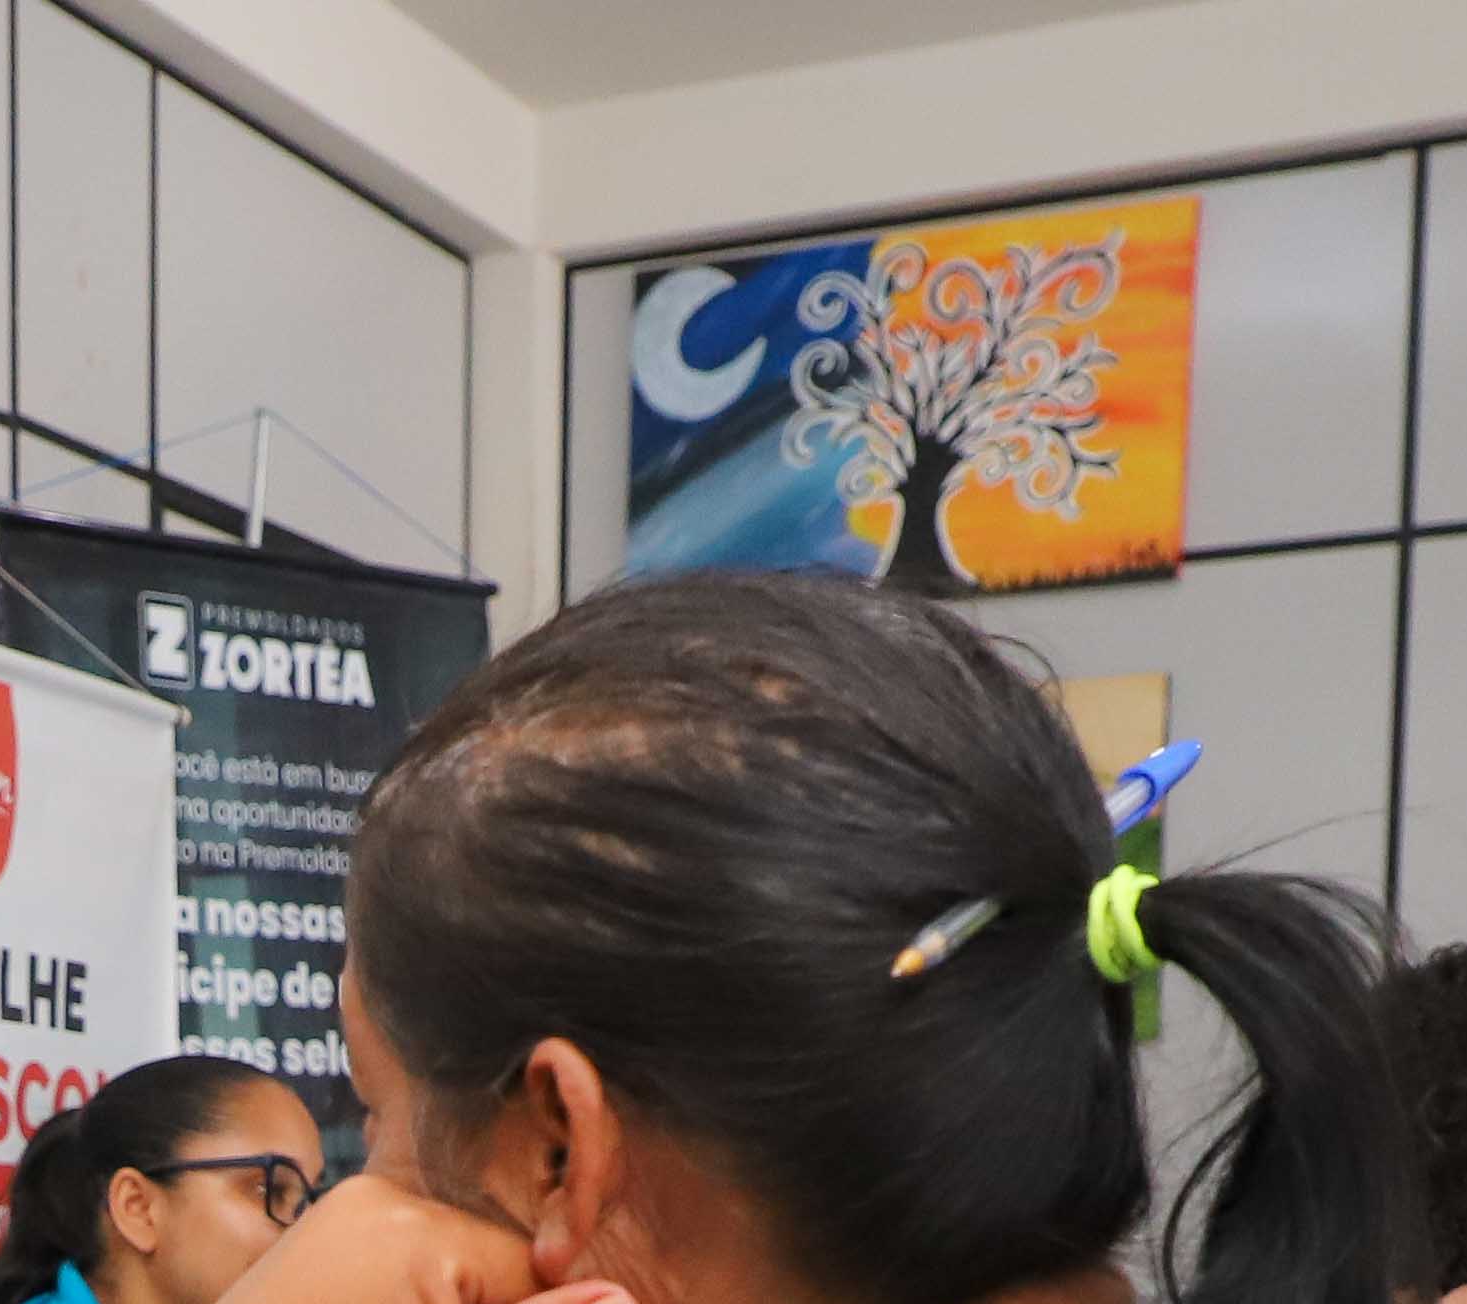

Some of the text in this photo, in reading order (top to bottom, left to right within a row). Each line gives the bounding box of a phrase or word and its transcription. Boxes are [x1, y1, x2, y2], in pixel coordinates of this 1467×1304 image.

[198, 630, 376, 709] ZORTÉA
[177, 949, 336, 1021] icipe de
